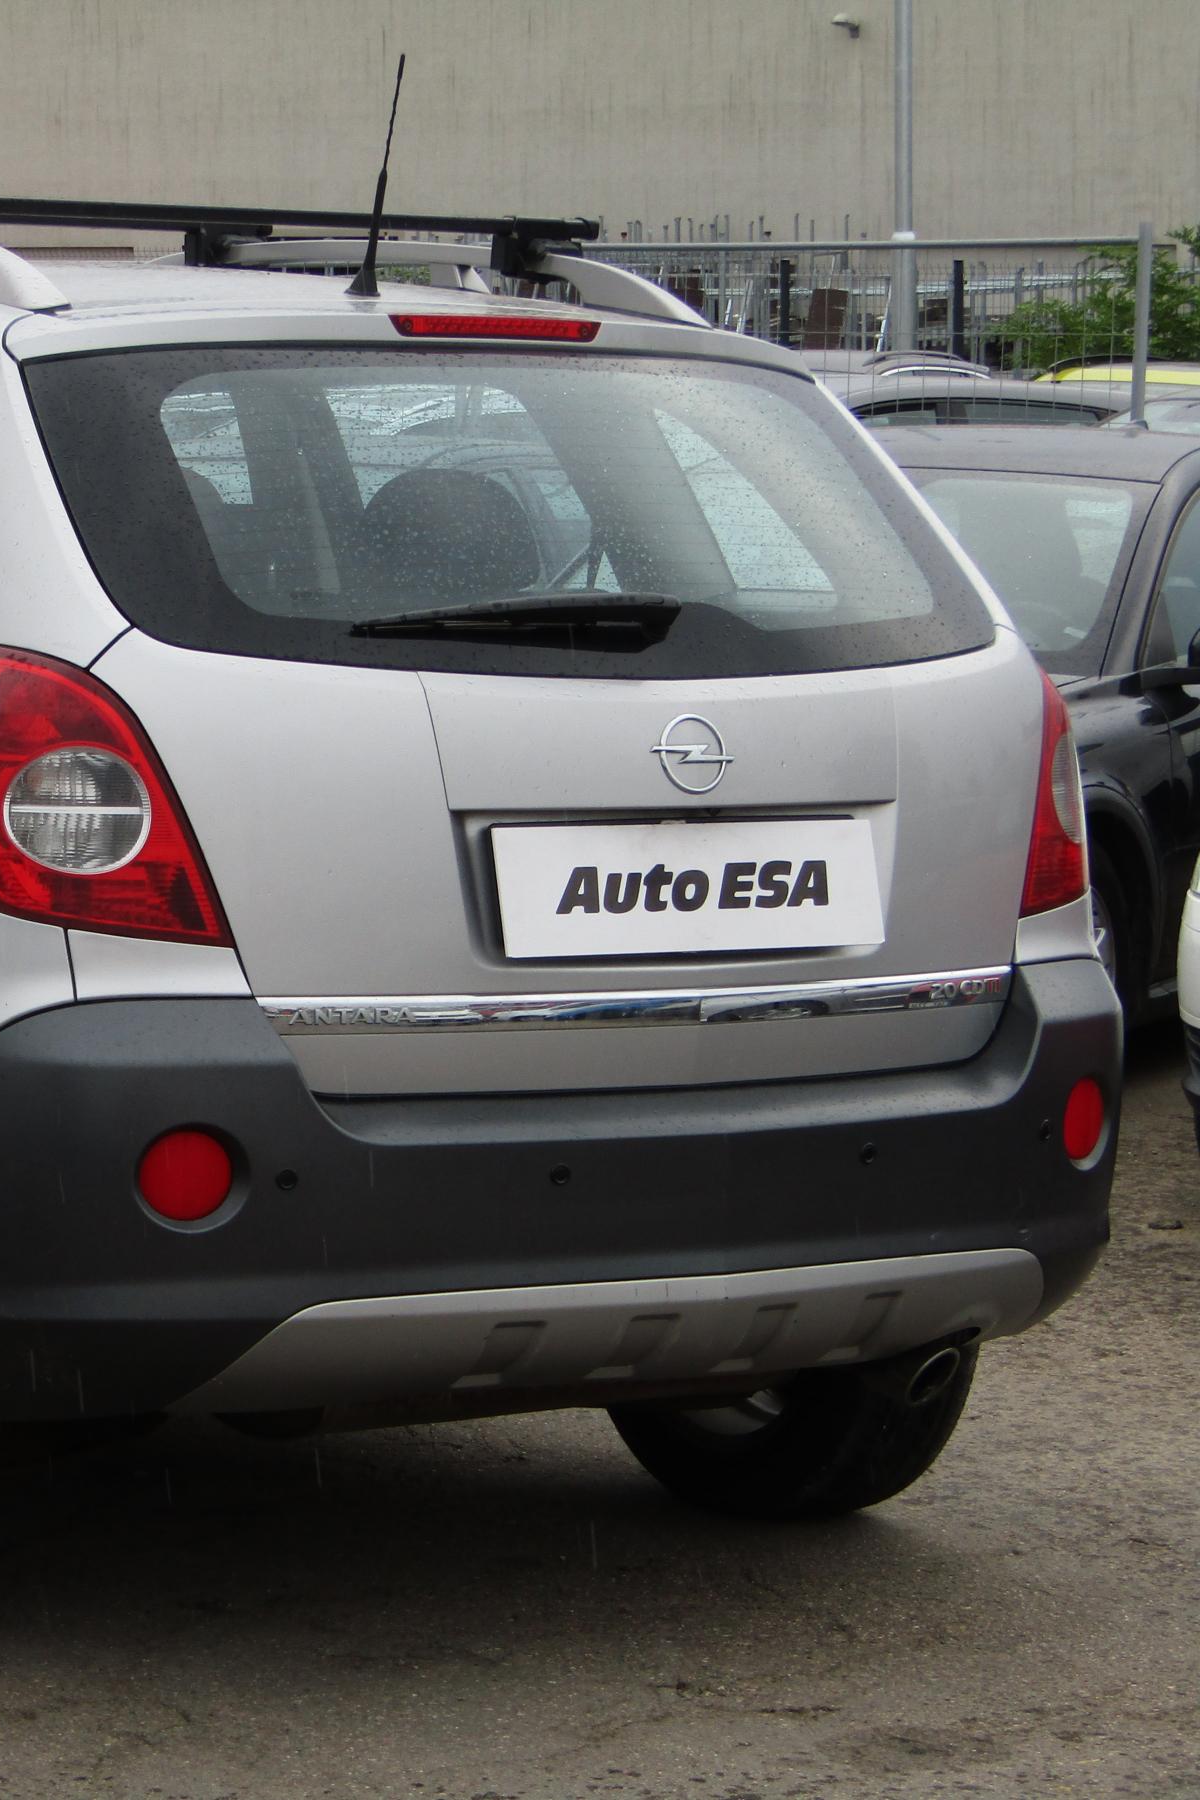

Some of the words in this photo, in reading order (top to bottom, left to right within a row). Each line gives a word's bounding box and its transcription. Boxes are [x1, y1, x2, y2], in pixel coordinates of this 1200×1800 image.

[555, 863, 710, 914] Auto
[717, 860, 829, 909] ESA
[289, 1006, 417, 1026] ANTARA
